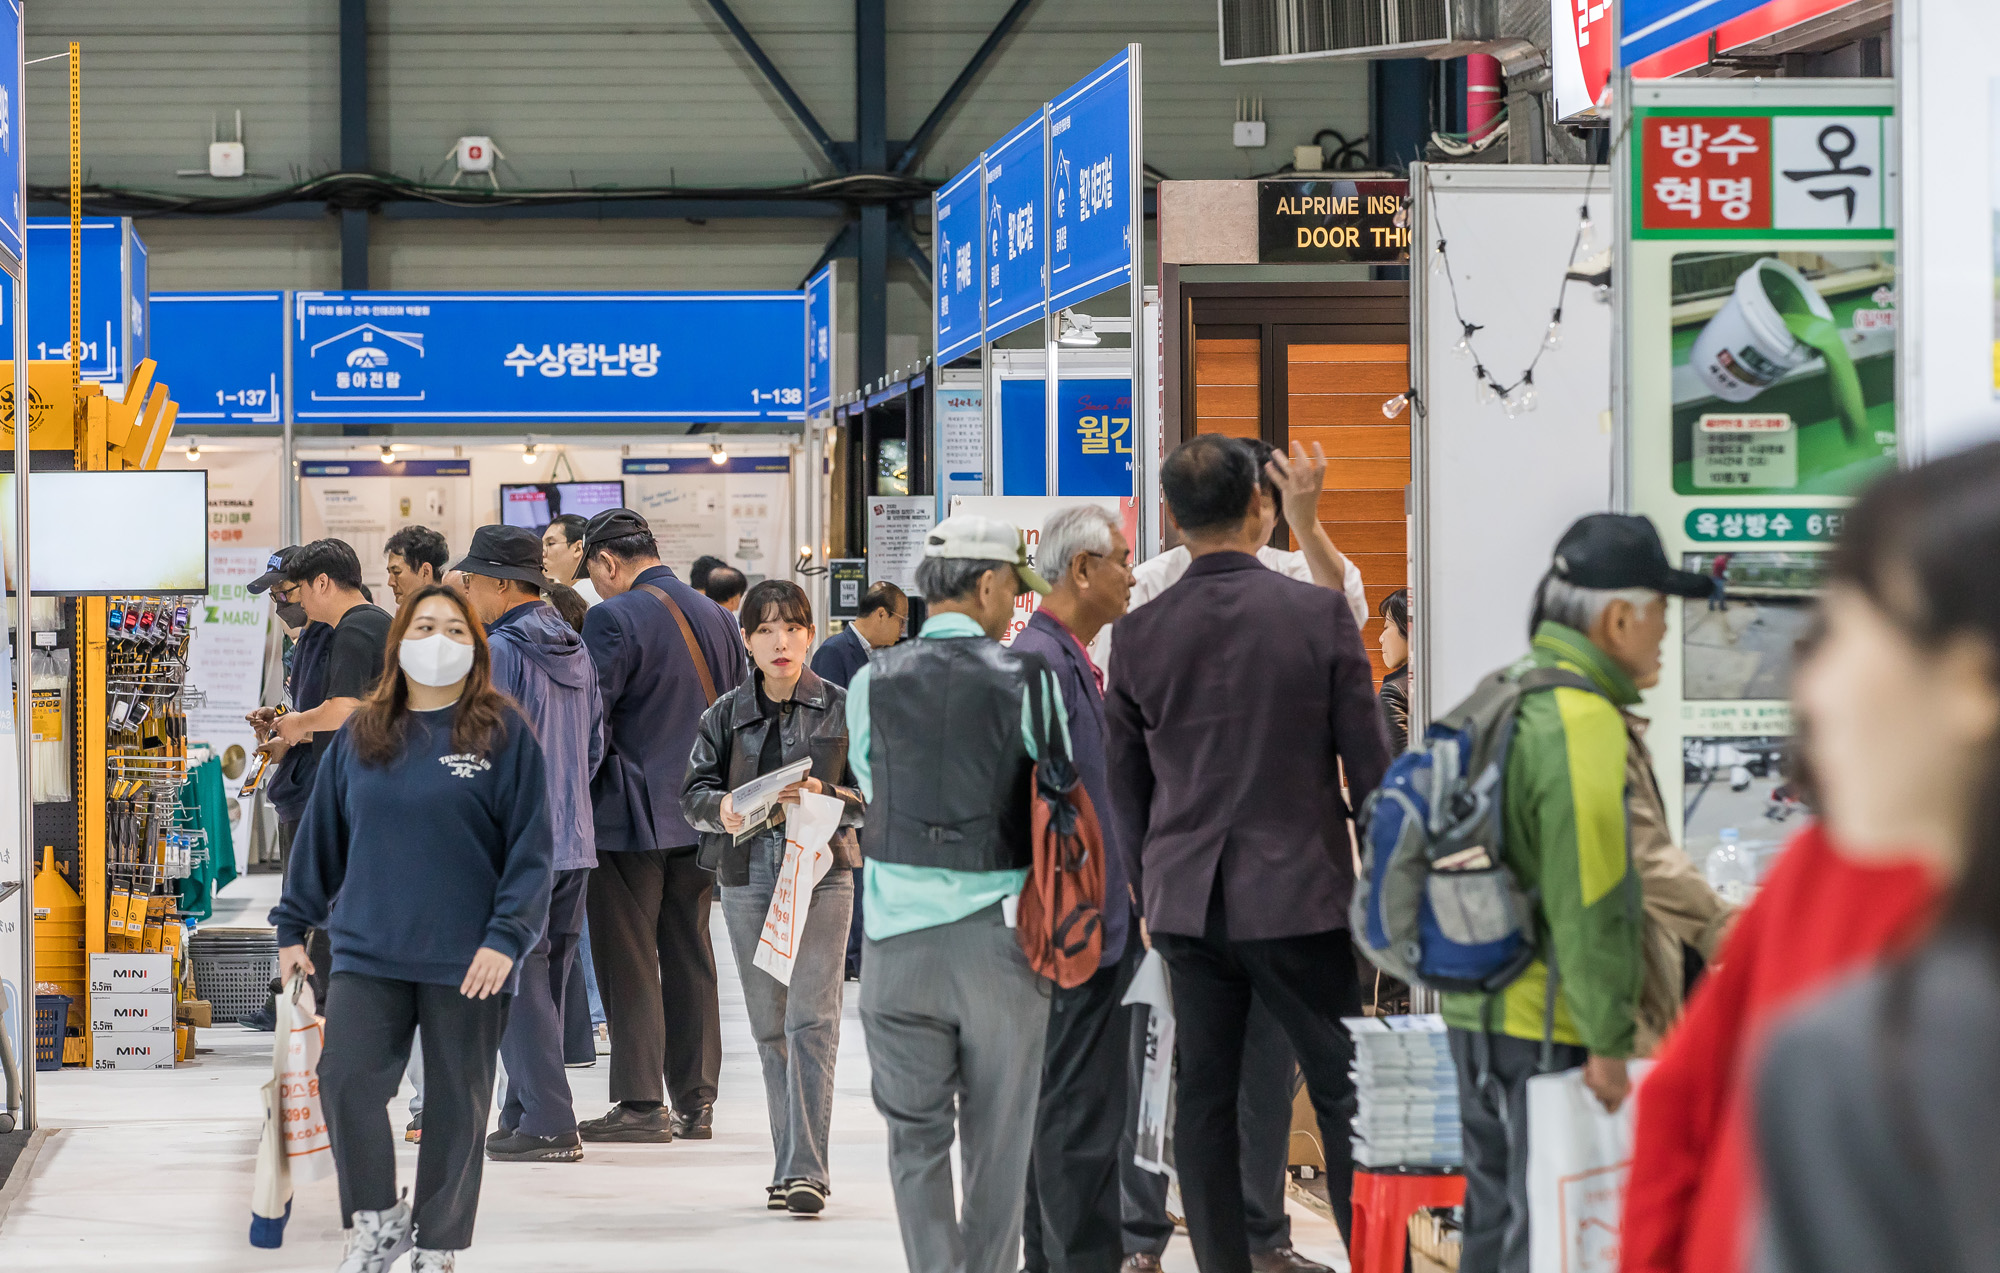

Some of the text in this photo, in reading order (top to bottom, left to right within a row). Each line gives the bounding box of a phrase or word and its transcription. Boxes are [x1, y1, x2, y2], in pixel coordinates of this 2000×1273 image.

[1659, 124, 1759, 168] 방수
[1276, 196, 1360, 215] ALPRIME
[1653, 177, 1753, 221] 혁명
[1297, 227, 1412, 248] DOOR THI
[503, 342, 661, 378] 수상한난방
[215, 389, 267, 407] 1-137
[751, 387, 802, 405] 1-138
[1695, 512, 1794, 539] 옥상방수
[222, 610, 260, 626] MARU
[113, 969, 147, 978] MINI
[92, 981, 112, 991] 5.5m
[114, 1008, 148, 1017] MINI
[93, 1020, 113, 1030] 5.5m
[116, 1046, 151, 1055] MINI
[95, 1059, 116, 1069] 5.5m
